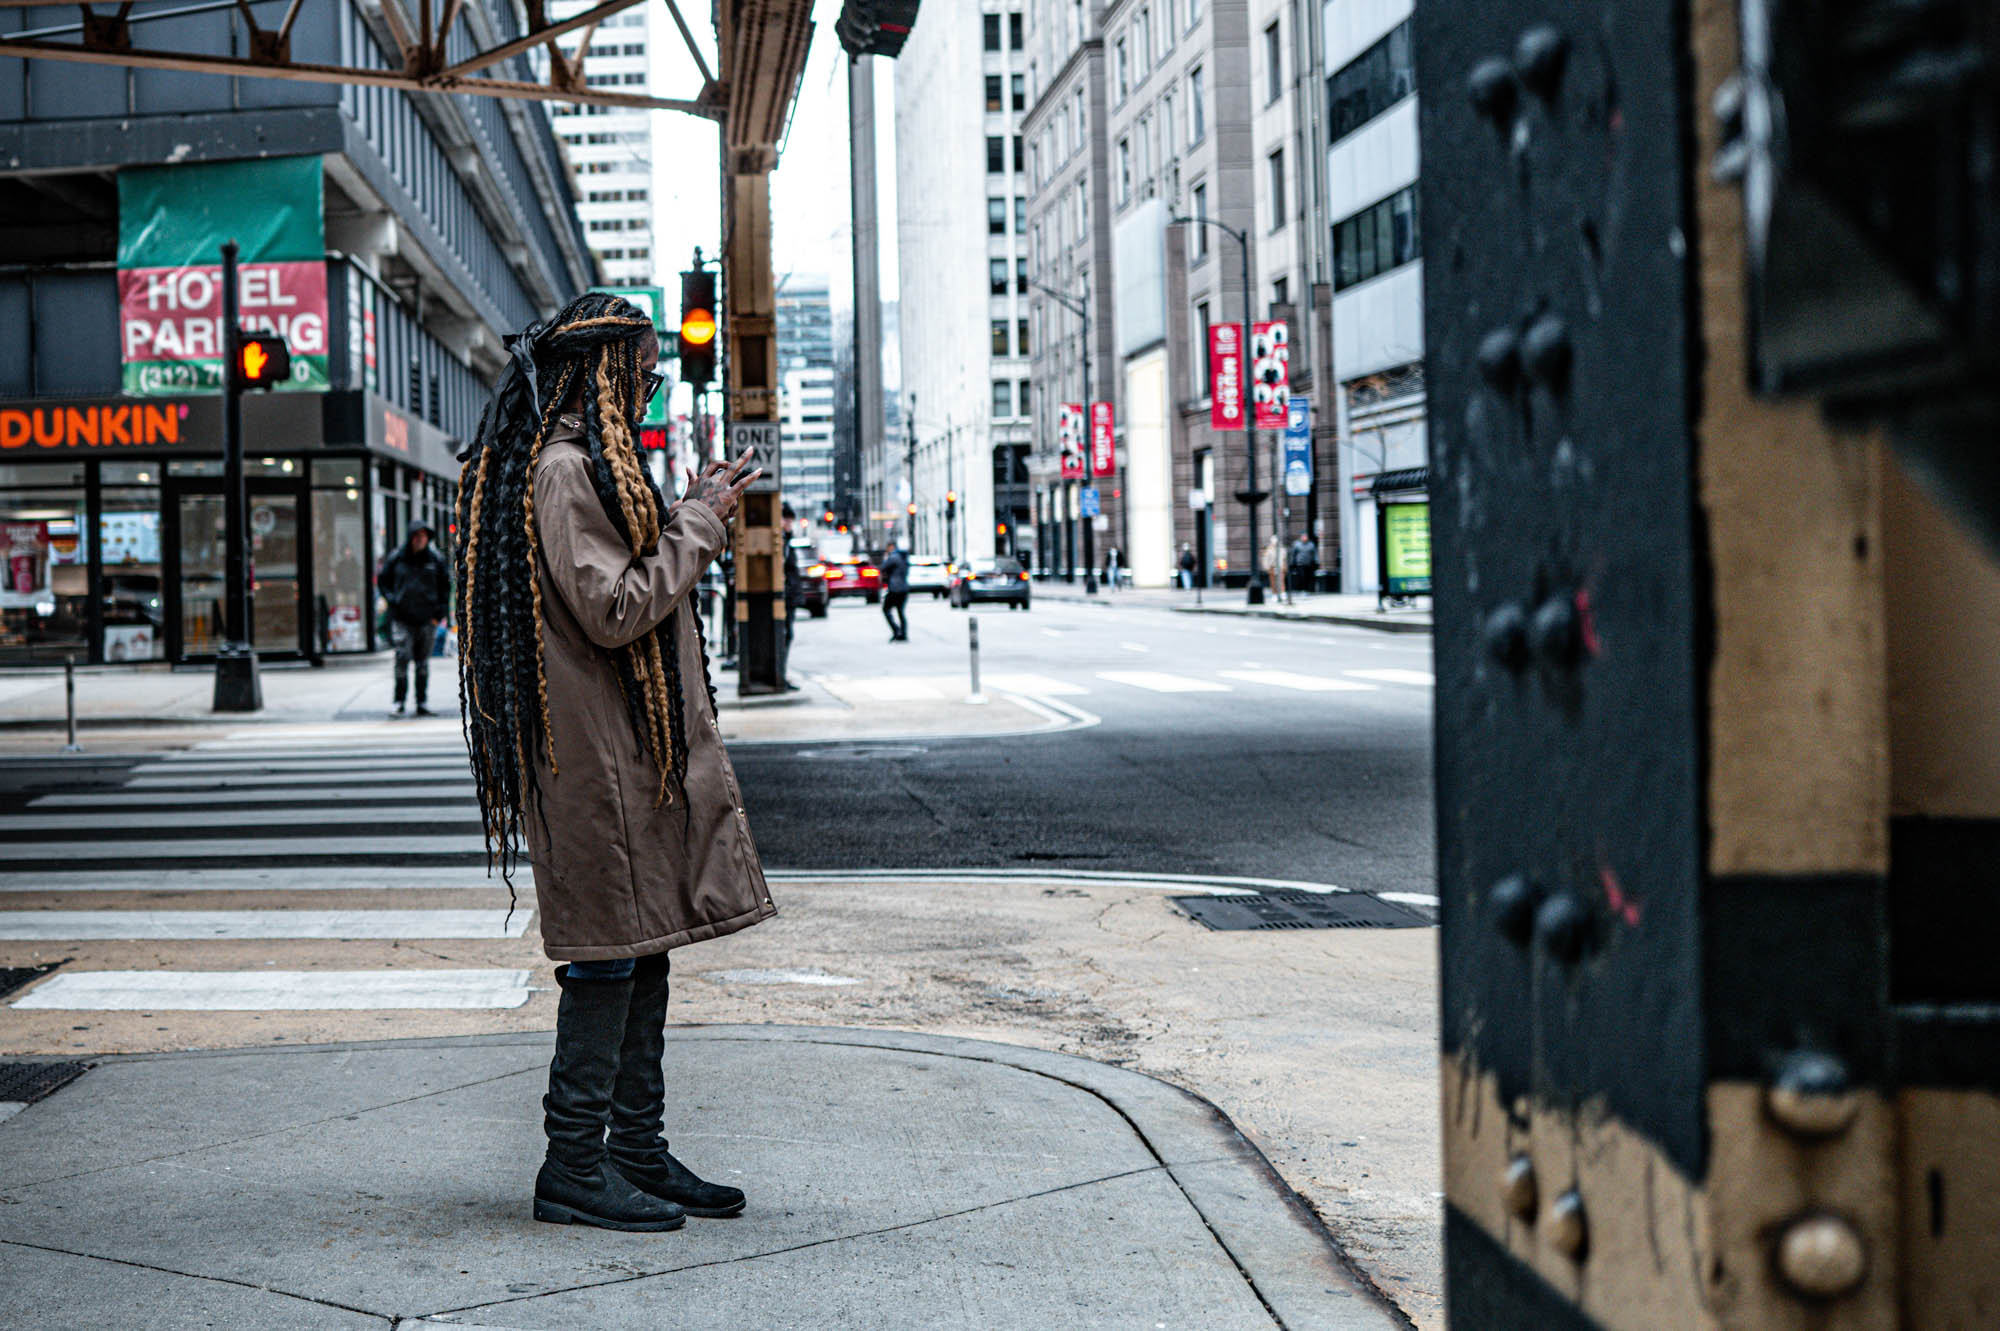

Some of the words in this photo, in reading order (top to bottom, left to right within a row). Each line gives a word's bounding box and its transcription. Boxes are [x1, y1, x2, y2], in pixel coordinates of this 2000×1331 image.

[149, 269, 297, 311] HOEL
[0, 403, 188, 448] DUNKIN'
[736, 428, 775, 446] ONE
